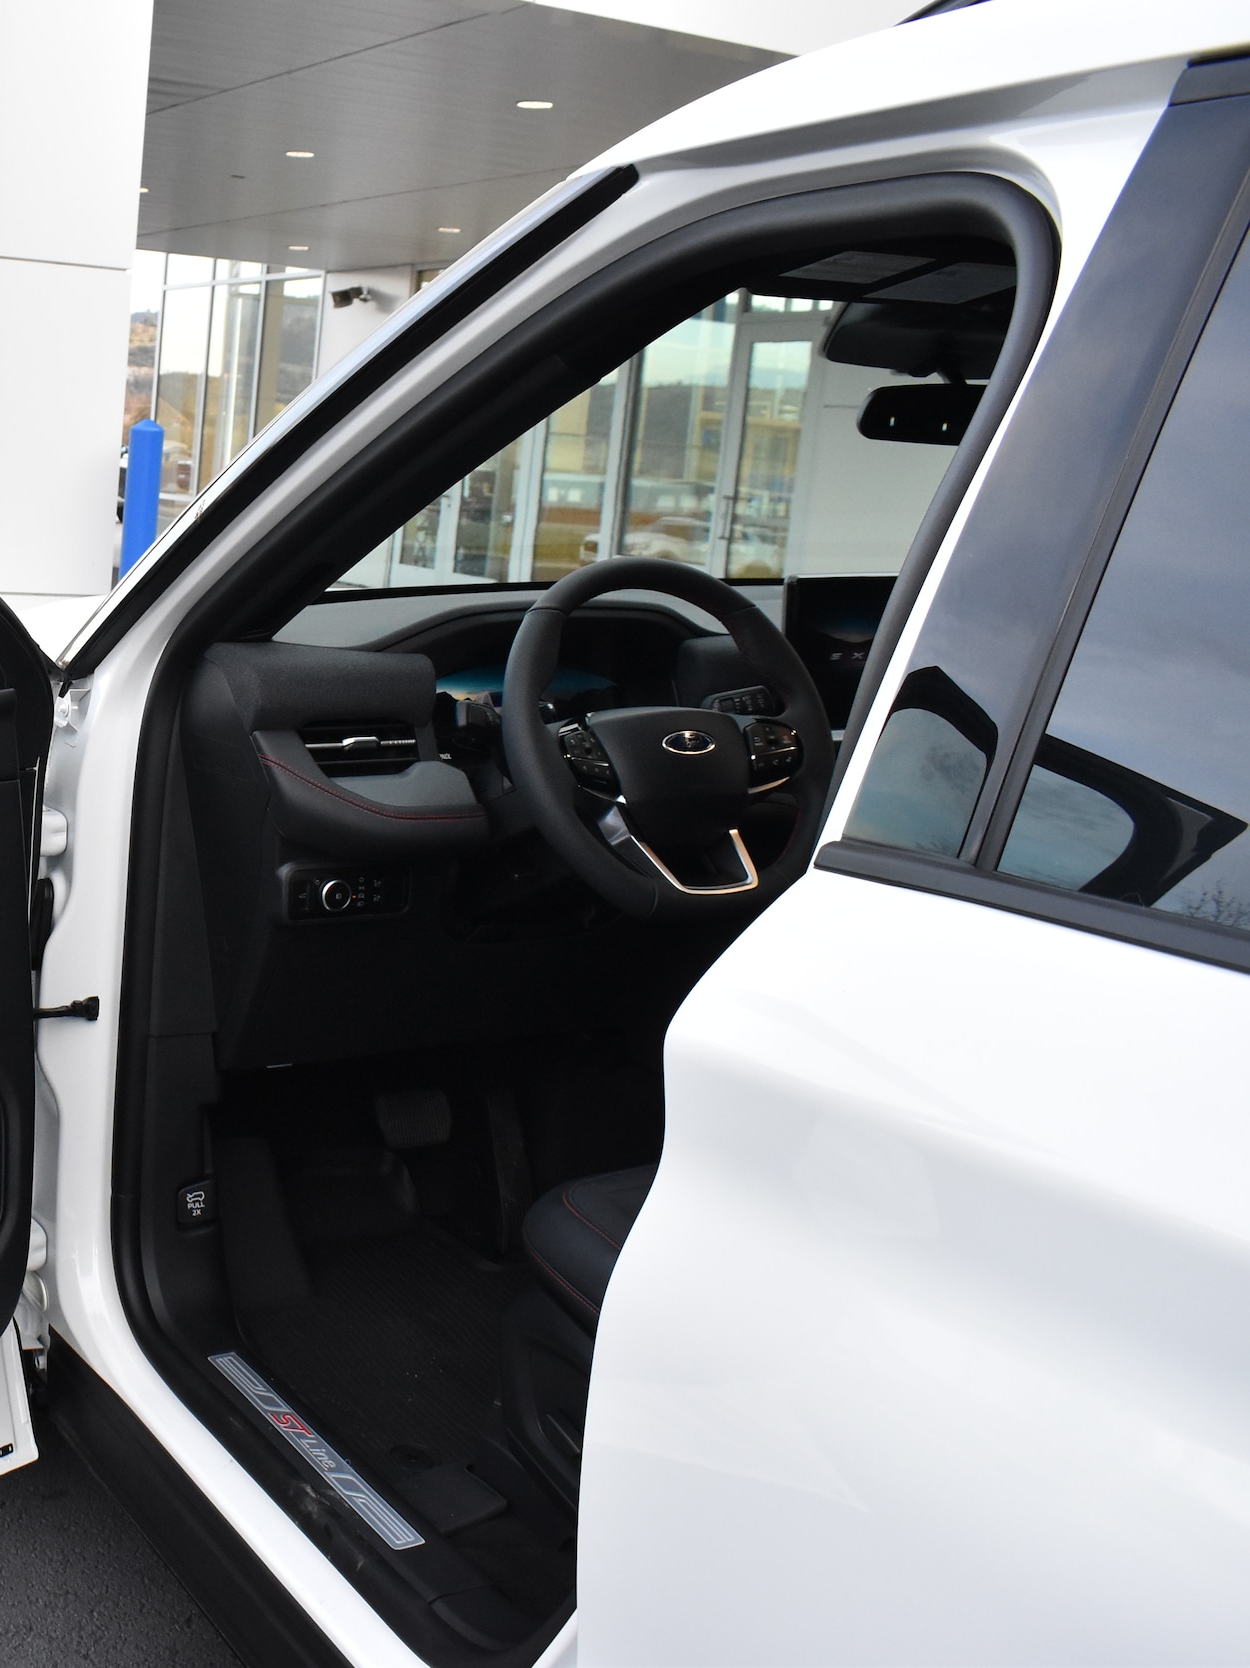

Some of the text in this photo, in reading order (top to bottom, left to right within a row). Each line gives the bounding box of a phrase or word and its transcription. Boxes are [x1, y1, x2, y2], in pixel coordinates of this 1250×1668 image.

[187, 1201, 205, 1210] PULL
[270, 1413, 336, 1469] ST Line
